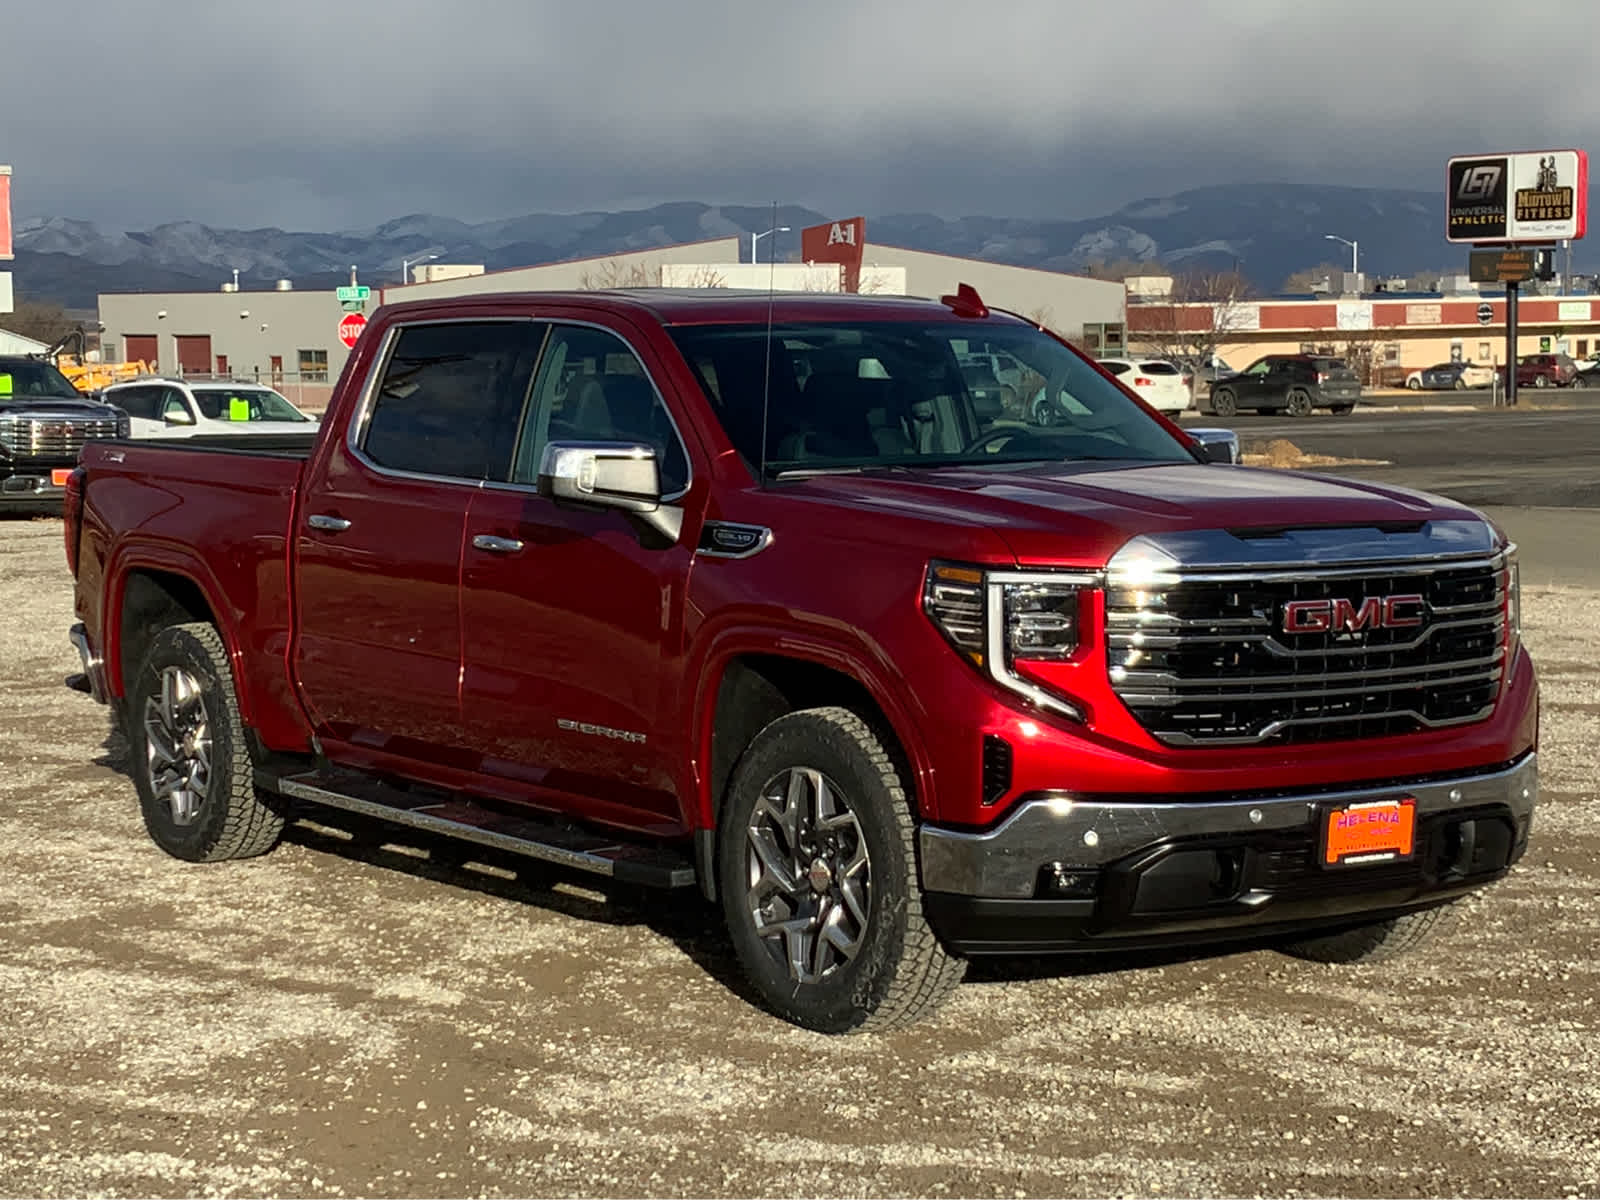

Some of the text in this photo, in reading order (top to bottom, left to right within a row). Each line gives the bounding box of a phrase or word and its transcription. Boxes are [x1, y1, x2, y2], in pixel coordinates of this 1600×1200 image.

[1518, 189, 1571, 207] MIDTOWN
[1451, 205, 1505, 216] UNIVERSAL
[1517, 207, 1571, 219] FITNESS
[1451, 215, 1506, 225] ATHLETIC
[342, 324, 366, 338] STO
[1284, 594, 1422, 633] GMC
[557, 718, 647, 744] SIERRA
[1336, 811, 1399, 830] HELENA
